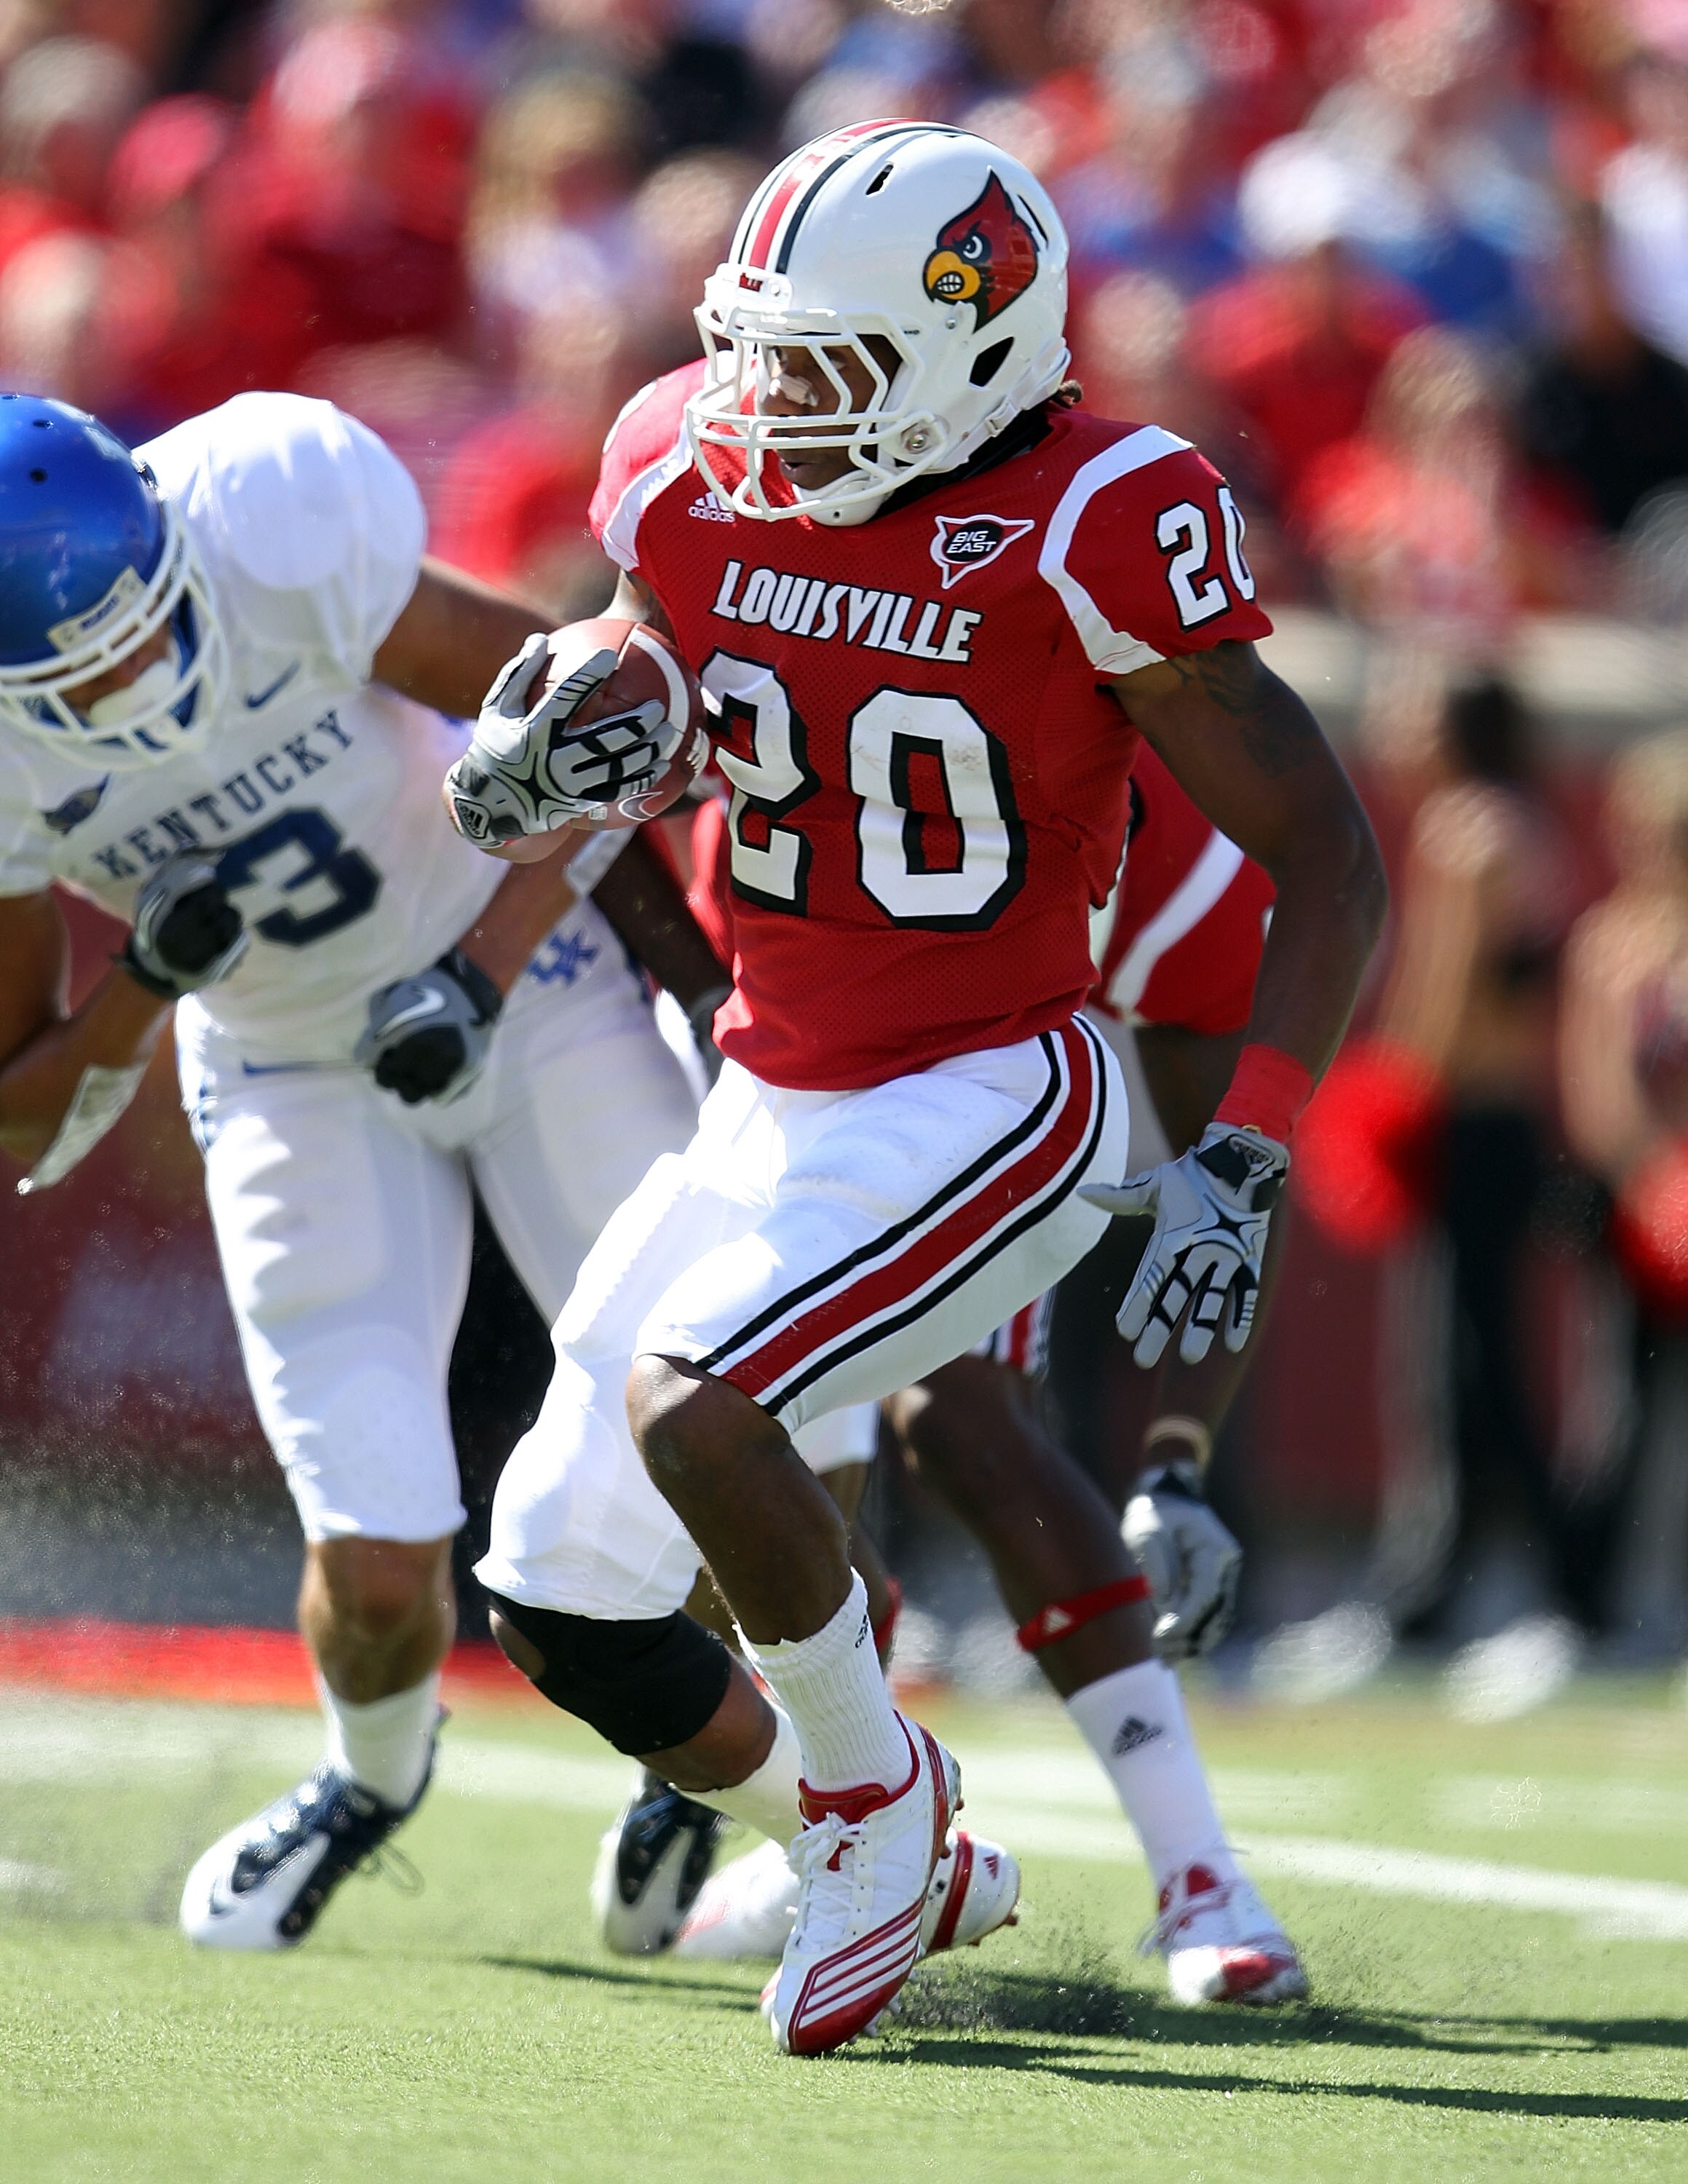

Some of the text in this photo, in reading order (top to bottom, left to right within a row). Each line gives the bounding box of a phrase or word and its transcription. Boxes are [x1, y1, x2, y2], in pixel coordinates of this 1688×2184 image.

[688, 506, 735, 523] adidas
[946, 542, 996, 553] EAST
[952, 531, 988, 543] BIG
[1154, 486, 1256, 633] 20
[710, 558, 983, 665] LOUISVILLE
[92, 708, 354, 879] KENTUCKY
[700, 645, 1028, 931] 20
[215, 806, 383, 951] 3
